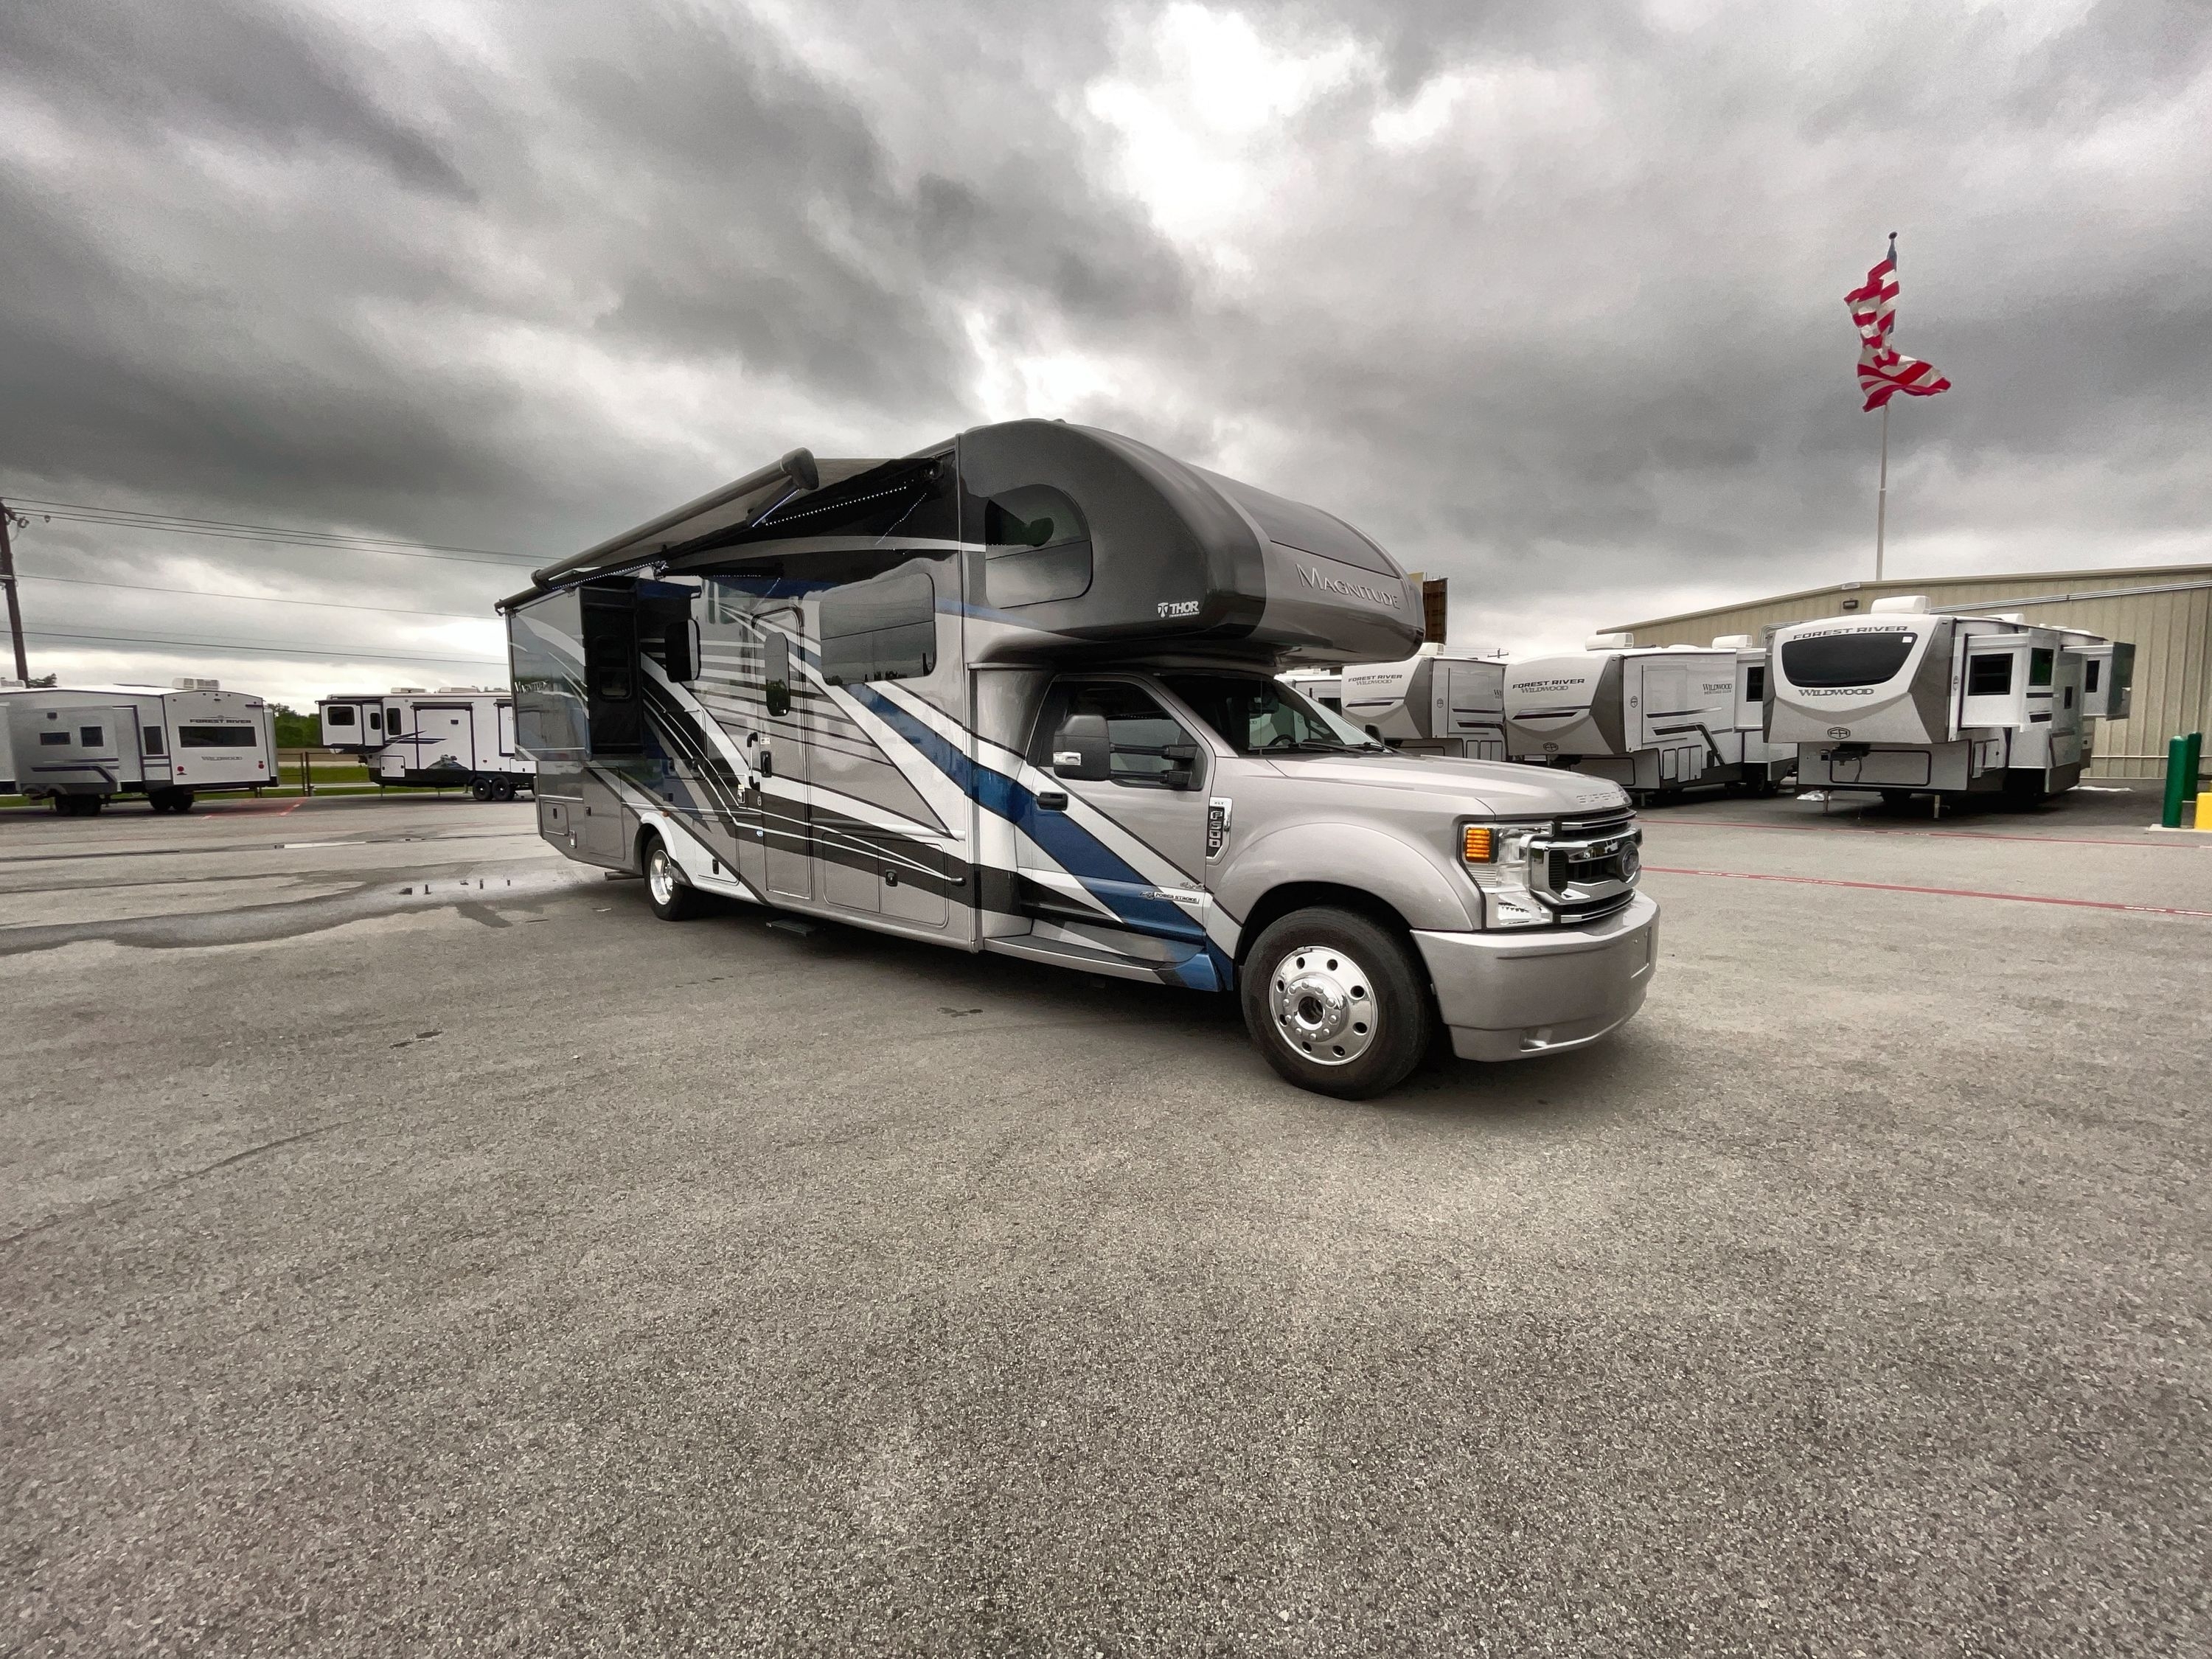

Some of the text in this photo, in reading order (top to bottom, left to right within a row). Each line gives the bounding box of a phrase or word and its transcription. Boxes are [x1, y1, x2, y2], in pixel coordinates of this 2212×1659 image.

[1295, 563, 1401, 610] MAGNITUDE
[1169, 601, 1199, 614] THOR
[1793, 627, 1854, 640] FOREST
[1512, 681, 1550, 689] FOREST
[1521, 685, 1569, 693] WILDWOOD
[1703, 683, 1732, 691] WILDWOOD
[1799, 688, 1874, 697] WILDWOOD
